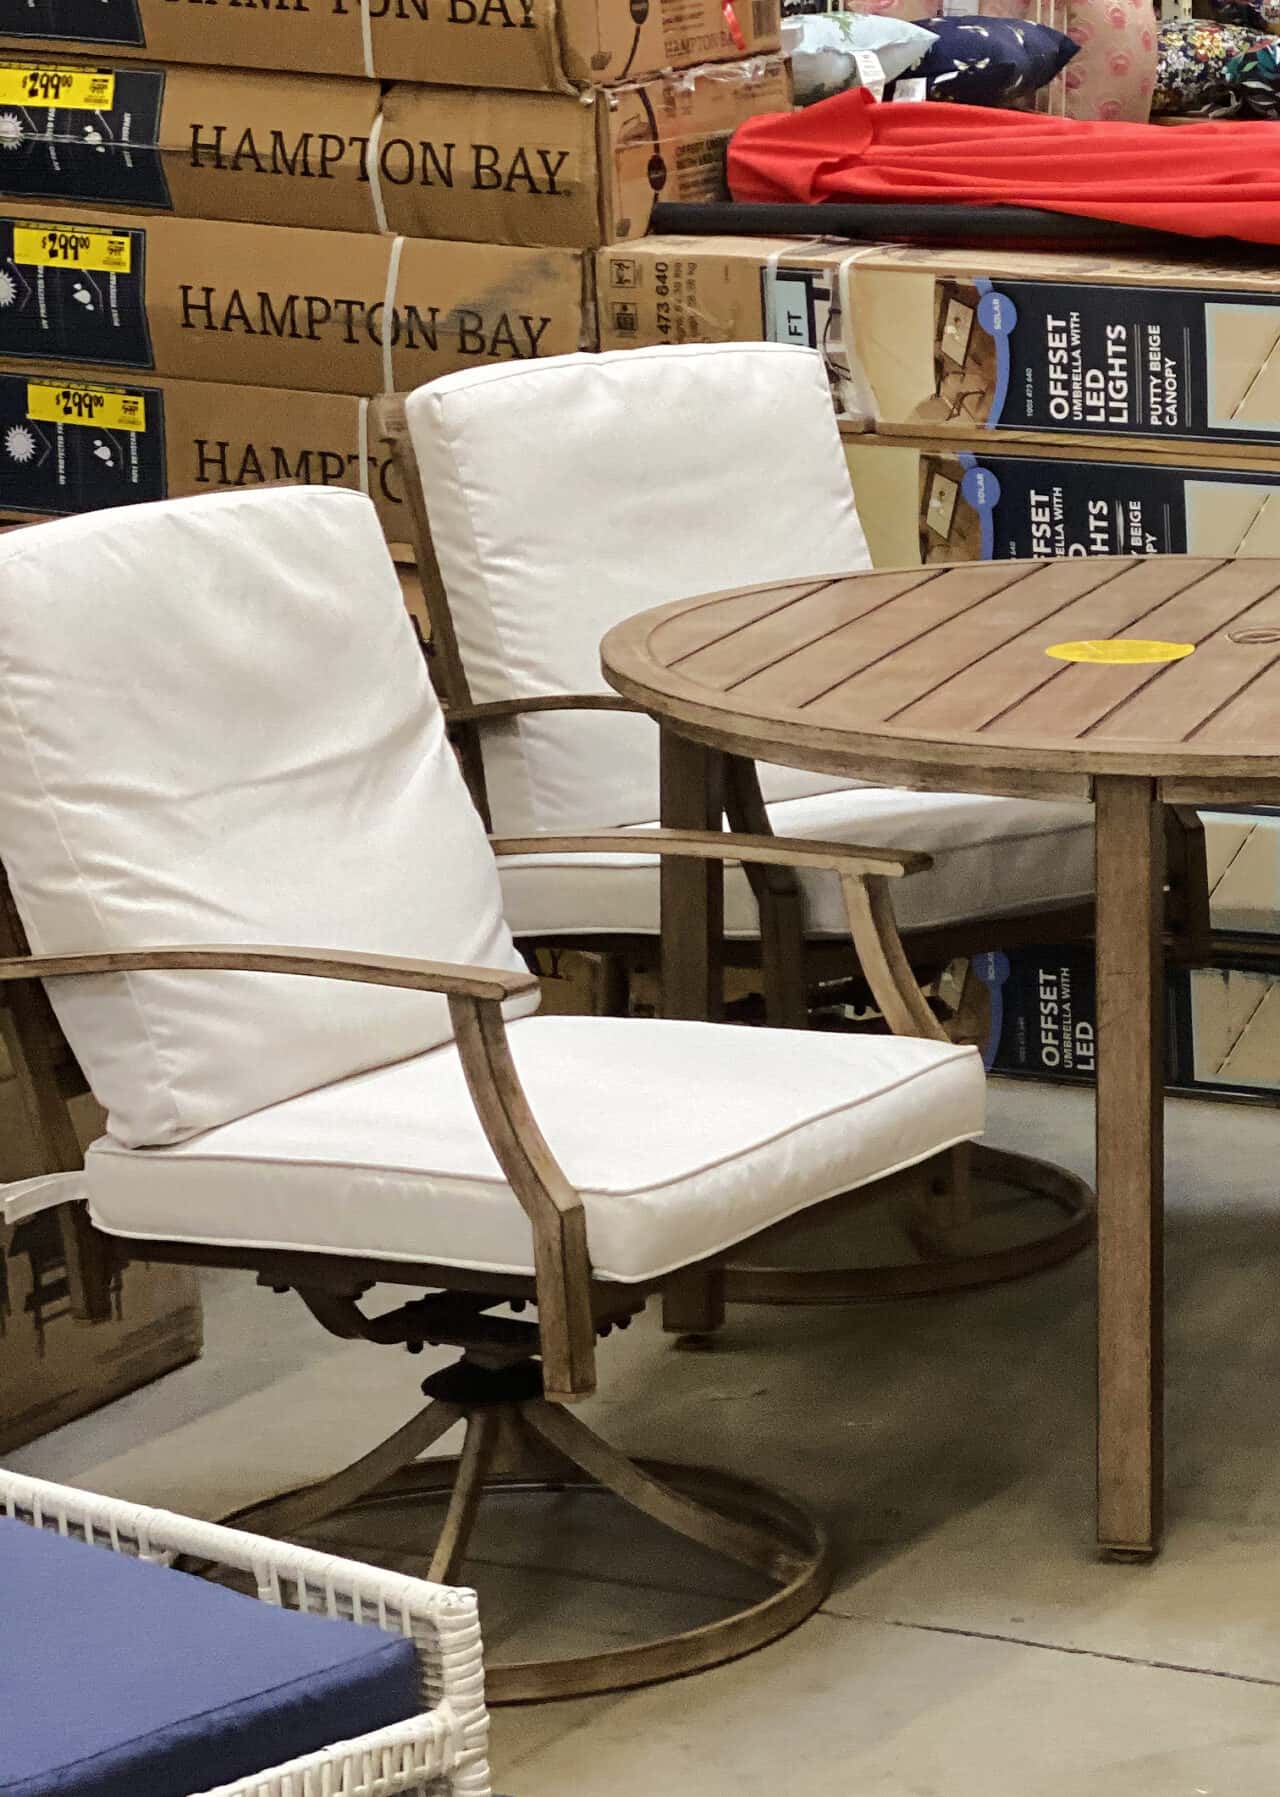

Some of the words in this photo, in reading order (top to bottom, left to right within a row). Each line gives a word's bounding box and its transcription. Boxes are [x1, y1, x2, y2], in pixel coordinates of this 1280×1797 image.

[189, 124, 455, 188] HAMPTON
[470, 144, 570, 196] BAY
[655, 261, 670, 295] 640
[179, 285, 439, 352] HAMPTON
[456, 309, 552, 360] BAY
[656, 301, 671, 336] 473
[788, 310, 803, 337] FT
[992, 299, 1002, 330] SOLAR
[1070, 312, 1081, 346] WITH
[1047, 315, 1069, 419] OFFSET
[1148, 325, 1160, 371] BEIGE
[1072, 349, 1083, 420] UMBRELLA
[1085, 369, 1105, 422] LED
[1107, 324, 1129, 423] LIGHTS
[1165, 358, 1178, 426] CANOPY
[1150, 375, 1163, 425] PUTTY
[194, 440, 402, 503] HAMP
[977, 473, 986, 504] SOLAR
[1053, 487, 1063, 520] WITH
[1088, 500, 1109, 552] HTS
[1130, 501, 1142, 546] BEIGE
[1055, 524, 1065, 555] ELLA
[1060, 967, 1071, 999] WITH
[1039, 969, 1060, 1066] OFFSET
[1062, 1002, 1073, 1068] UMBRELLA
[1075, 1021, 1095, 1070] LED
